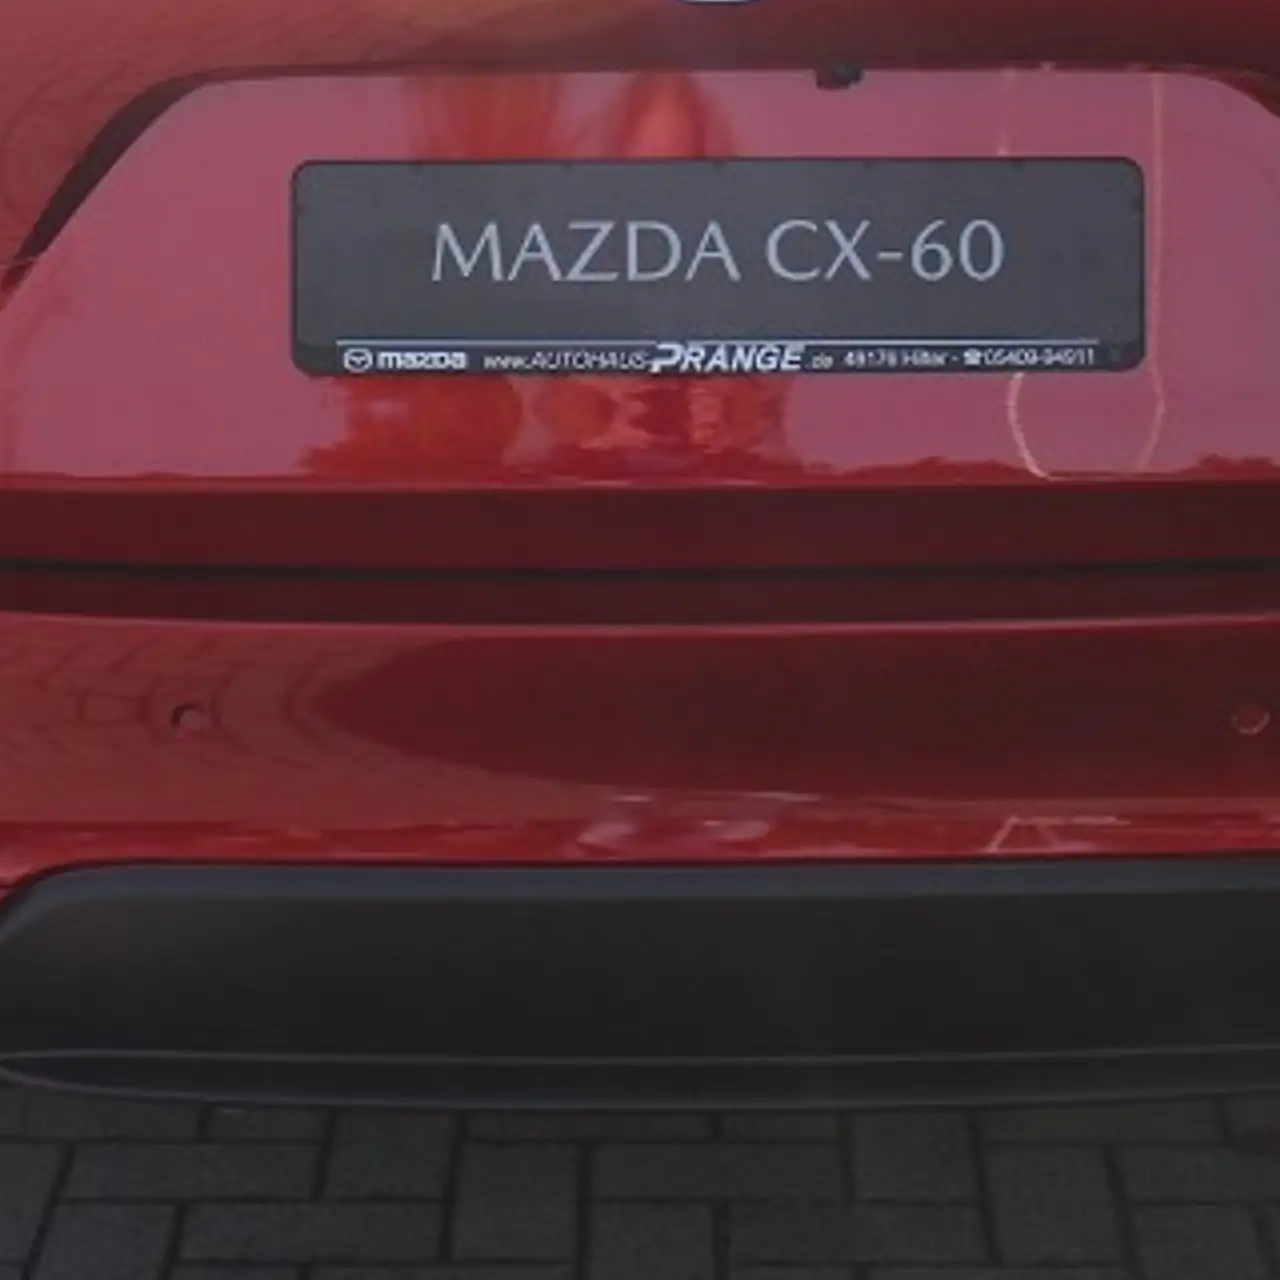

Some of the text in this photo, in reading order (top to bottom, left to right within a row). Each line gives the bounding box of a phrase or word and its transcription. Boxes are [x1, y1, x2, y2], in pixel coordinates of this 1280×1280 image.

[431, 220, 1003, 281] MAZDA CX-60
[377, 351, 467, 369] mazda
